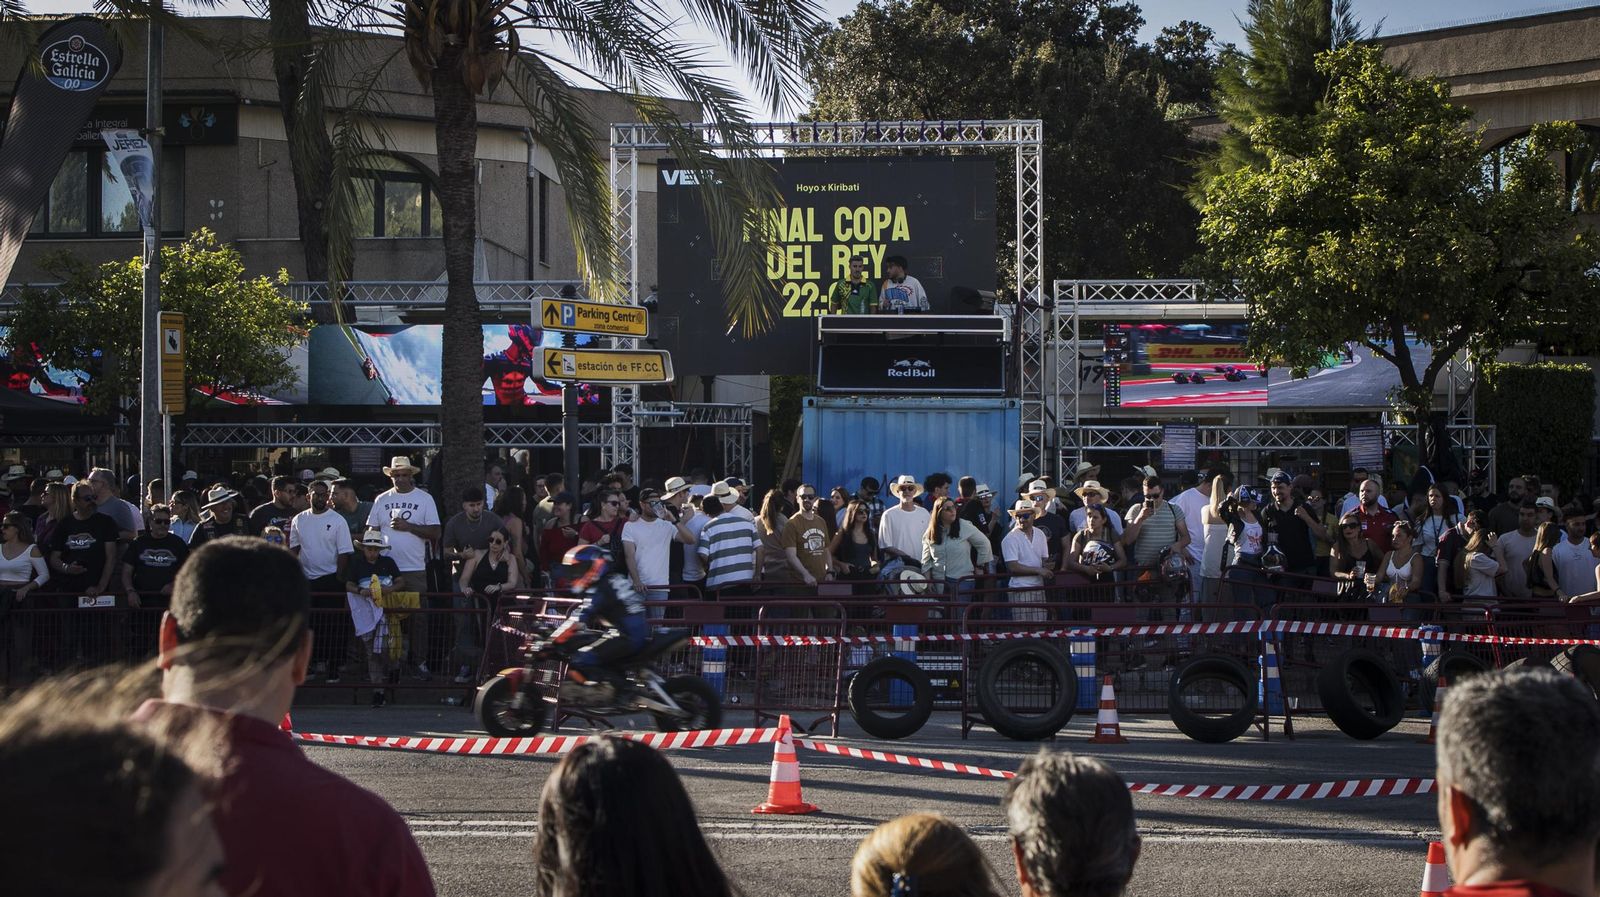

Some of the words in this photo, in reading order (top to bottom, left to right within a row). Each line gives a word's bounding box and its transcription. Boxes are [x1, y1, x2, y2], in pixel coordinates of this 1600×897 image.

[51, 48, 100, 67] Estrella
[52, 62, 96, 80] Galicia
[112, 138, 148, 151] JEREZ
[796, 184, 819, 193] Hoyo
[827, 183, 860, 192] Kiribati
[834, 206, 910, 242] COPA
[766, 244, 820, 280] DEL
[832, 244, 886, 279] REY
[577, 307, 610, 323] Parking
[577, 361, 614, 371] estación
[617, 362, 628, 371] de
[630, 362, 661, 373] FF.CC.
[888, 368, 911, 377] Red
[912, 368, 936, 377] Bull
